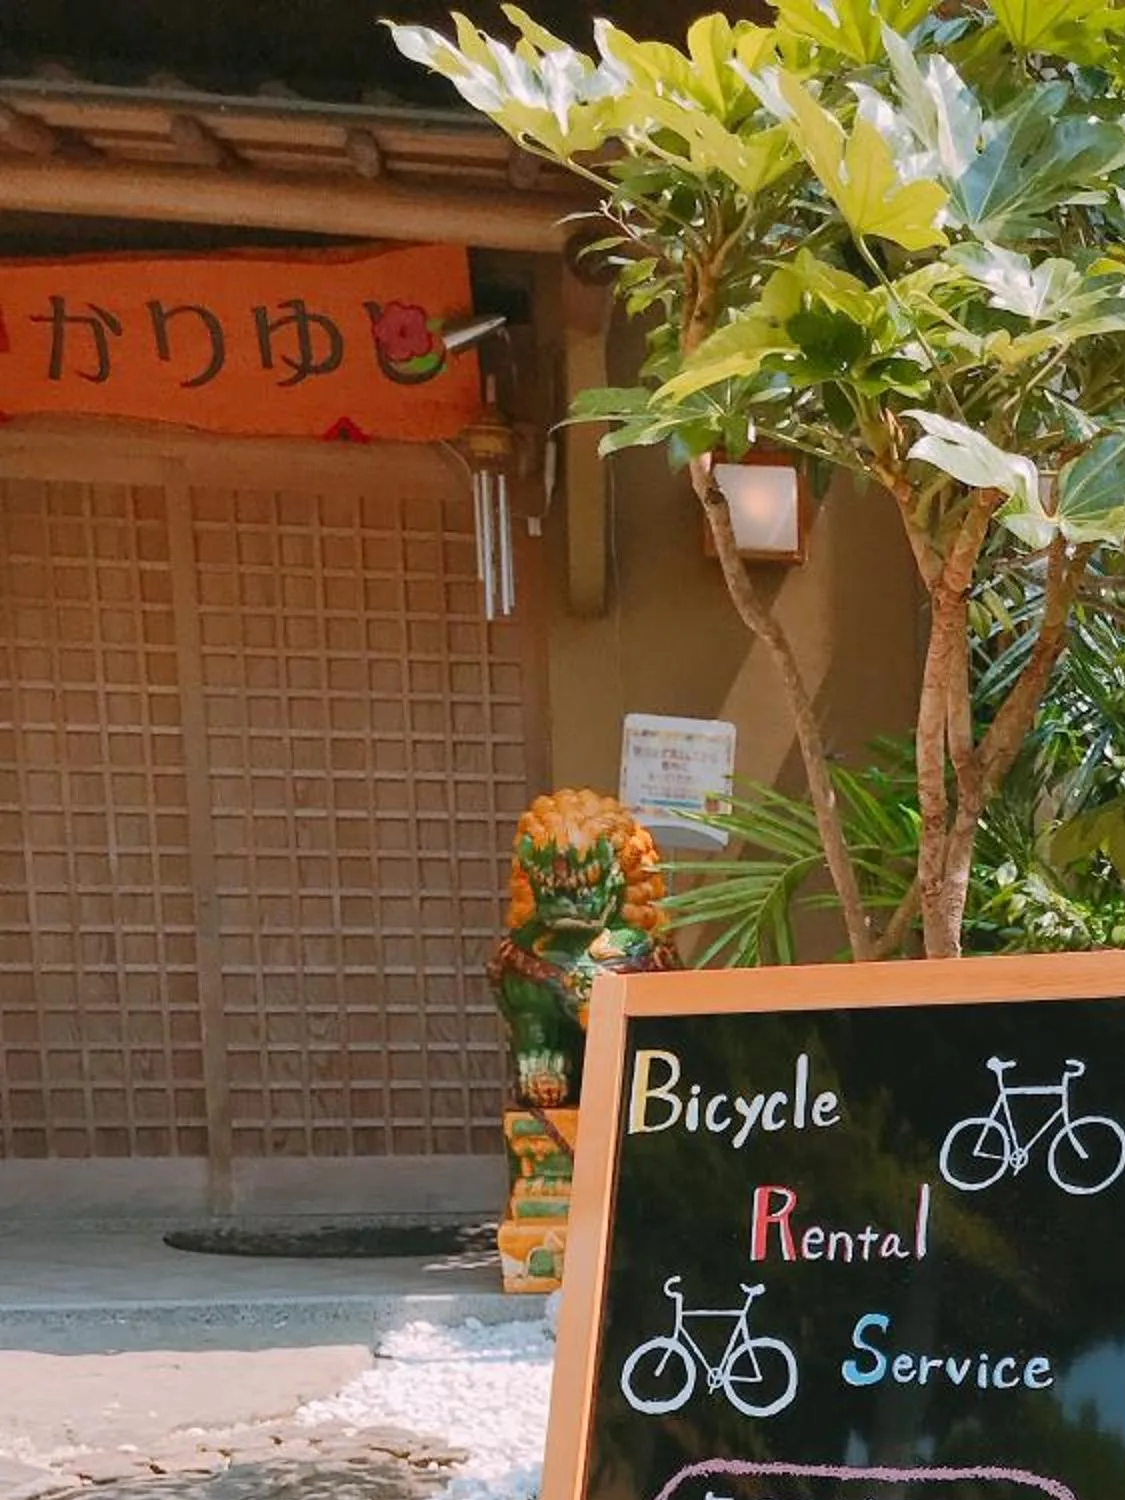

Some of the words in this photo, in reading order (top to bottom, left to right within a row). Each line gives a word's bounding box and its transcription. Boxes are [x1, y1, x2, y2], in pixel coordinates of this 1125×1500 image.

[627, 1049, 841, 1149] Bicycle
[750, 1183, 930, 1263] Rental
[841, 1313, 1054, 1389] Service
